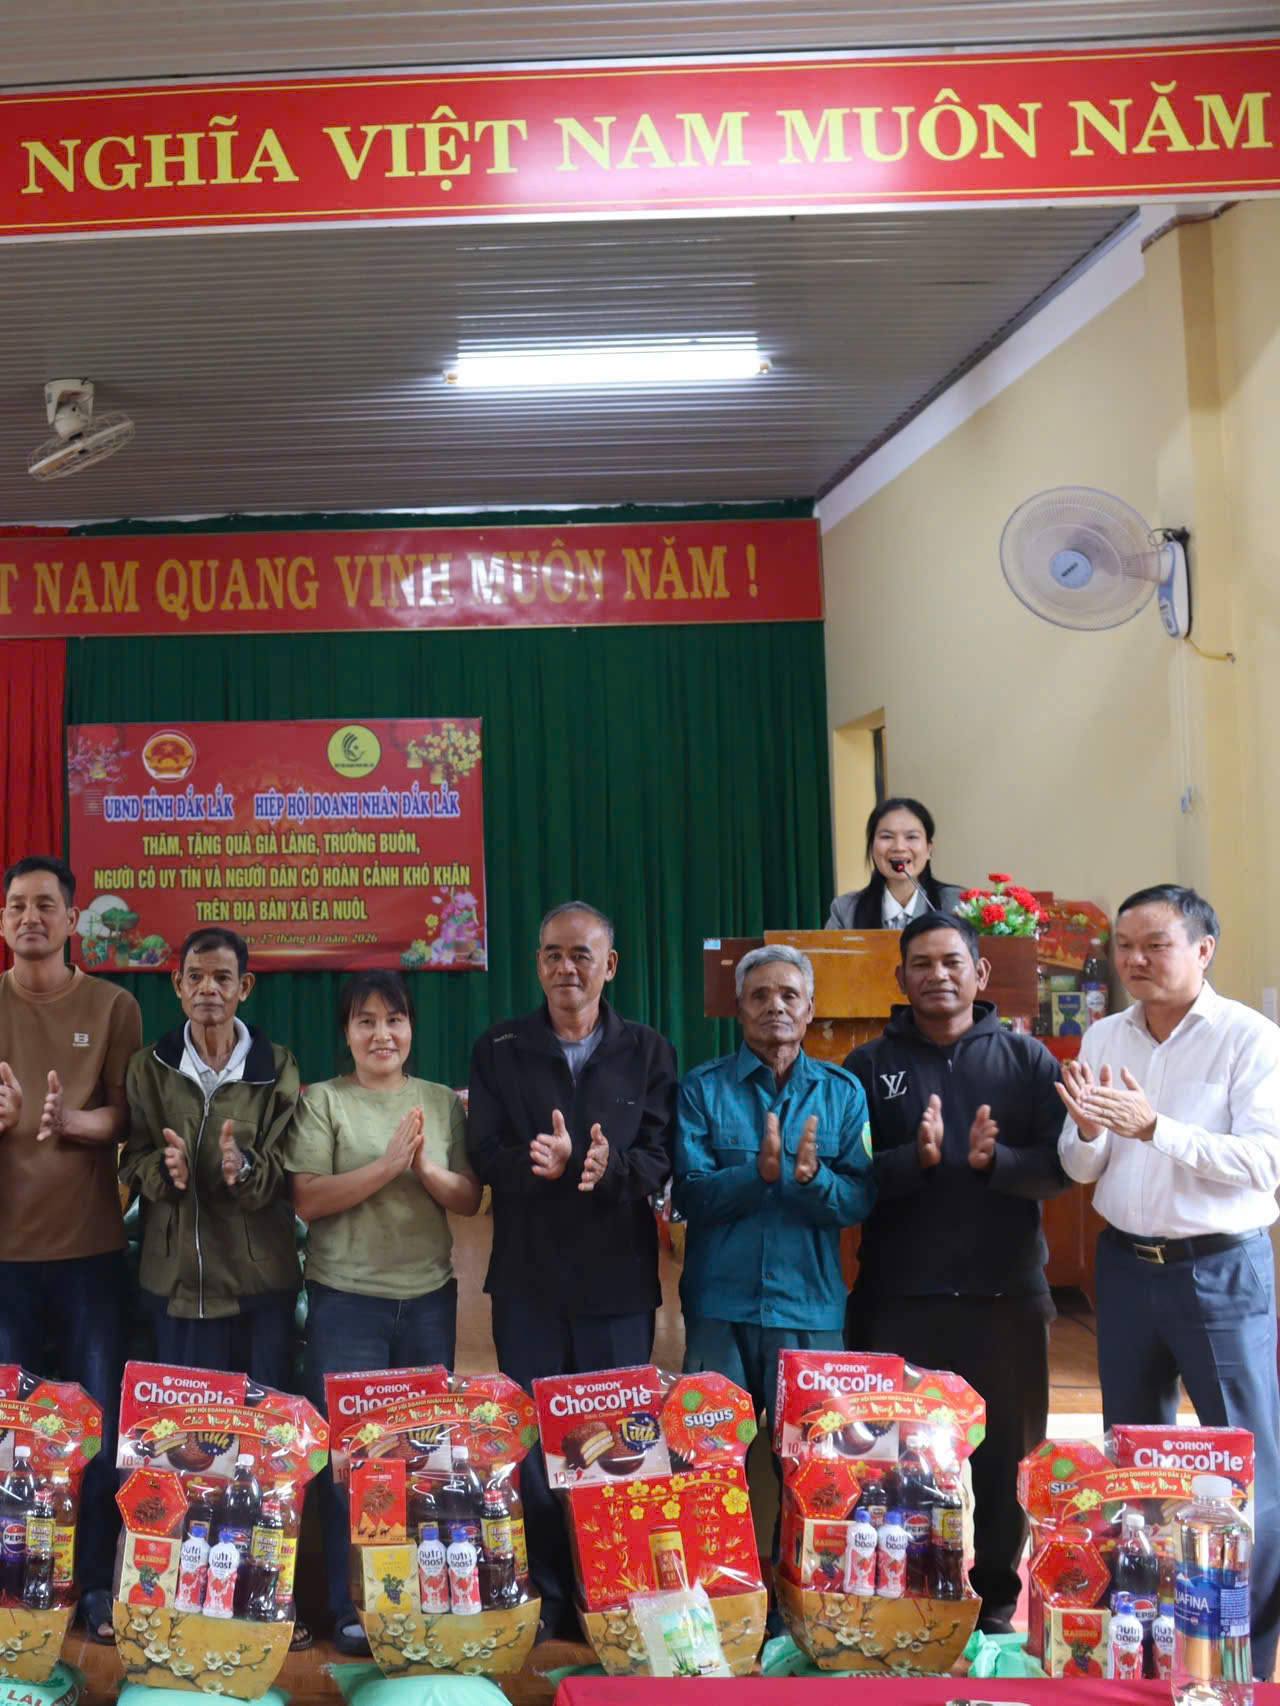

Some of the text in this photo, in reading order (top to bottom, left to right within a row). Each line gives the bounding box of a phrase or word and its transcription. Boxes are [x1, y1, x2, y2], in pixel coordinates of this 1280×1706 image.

[21, 115, 299, 195] NGHĨA
[322, 106, 528, 191] VIỆT
[556, 111, 751, 171] NAM
[776, 88, 1042, 165] MUÔN
[1070, 81, 1273, 157] NĂM
[34, 560, 140, 614] NAM
[156, 556, 318, 621] QUANG
[334, 553, 453, 610] VINH
[469, 538, 605, 604] MUÔN
[622, 536, 729, 601] NĂM
[747, 544, 759, 597] !
[104, 783, 234, 821] UBND TỈNH ĐẮK LẮK
[255, 781, 460, 825] HIỆP HỘI DOANH NHÂN ĐẮK LẮK
[142, 827, 420, 858] THĂM, TẶNG QUÀ GIÀ LÀNG, TRƯỞNG BUÔN,
[94, 860, 470, 888] NGƯỜI CÓ UY TÍN VÀ NGƯỜI DÂN CÓ HOÀN CẢNH KHÓ KHĂN
[196, 896, 368, 925] TRÊN ĐỊA BÀN XÃ EA NUÔL
[260, 934, 273, 944] 27
[276, 932, 306, 945] tháng
[325, 932, 348, 944] năm
[352, 934, 378, 944] 2026
[835, 1364, 868, 1373] ORION
[174, 1379, 208, 1388] ORION
[376, 1384, 410, 1392] ORION
[586, 1381, 622, 1392] ORION
[797, 1369, 894, 1393] ChocoPie
[134, 1382, 234, 1406] ChocoPie
[549, 1387, 652, 1416] ChocoPie
[684, 1407, 734, 1428] sugus
[1174, 1441, 1213, 1451] ORION
[1133, 1448, 1244, 1471] ChocoPie
[4, 1534, 26, 1542] PEPS
[1175, 1587, 1212, 1613] UAFINA
[1136, 1611, 1156, 1619] EPSI
